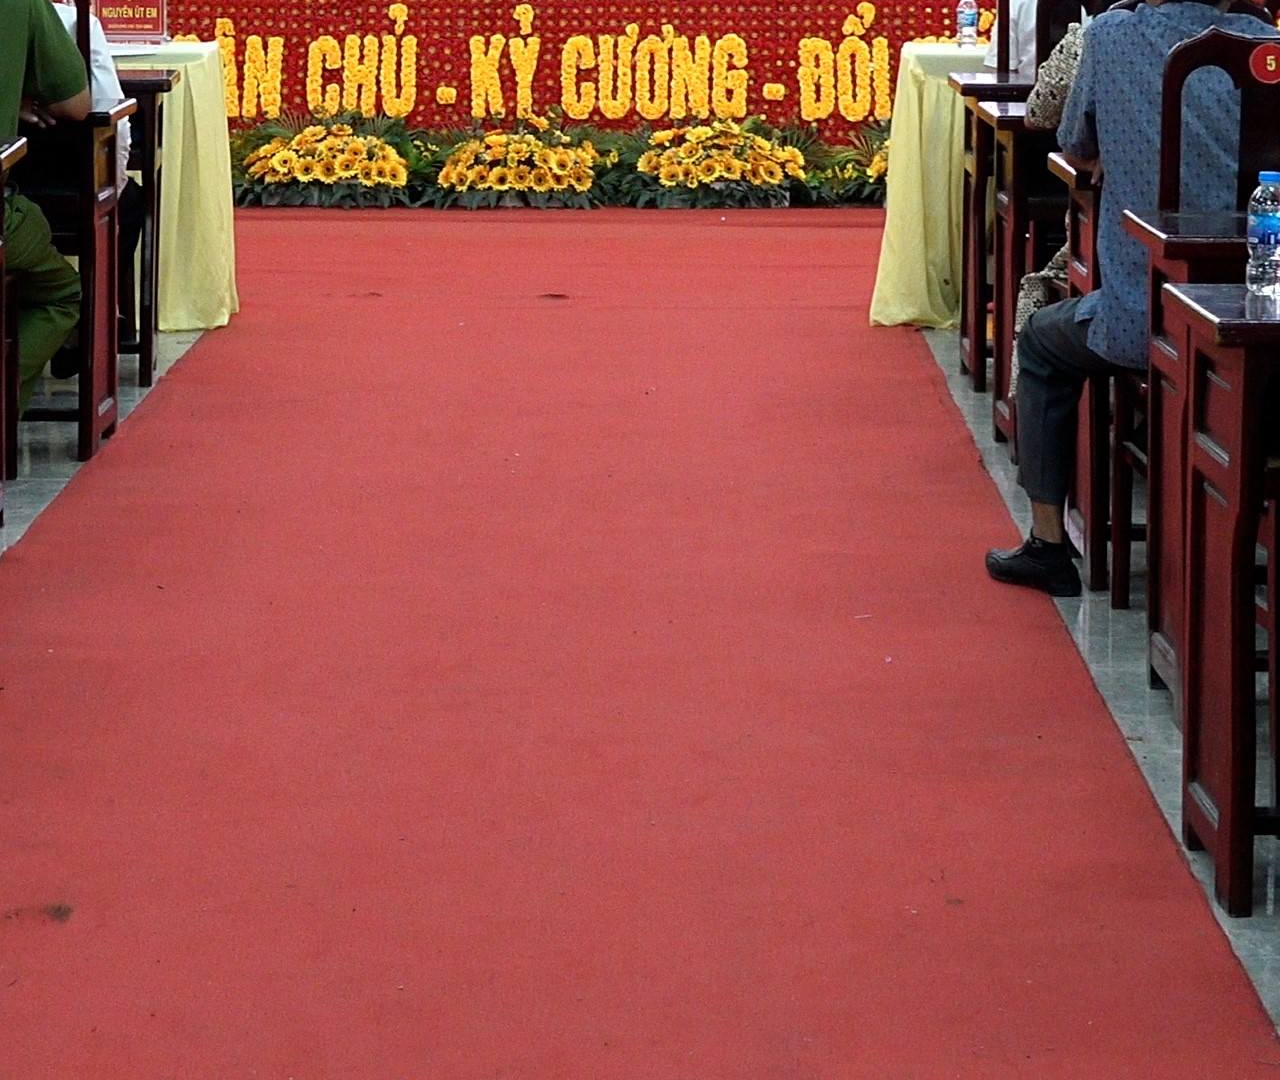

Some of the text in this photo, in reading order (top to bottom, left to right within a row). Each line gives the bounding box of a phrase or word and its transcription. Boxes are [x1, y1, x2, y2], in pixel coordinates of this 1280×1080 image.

[146, 7, 158, 18] EM
[212, 17, 285, 119] ÂN
[306, 3, 419, 119] CHỦ
[561, 22, 748, 121] CƯƠNG
[1265, 55, 1277, 72] 5
